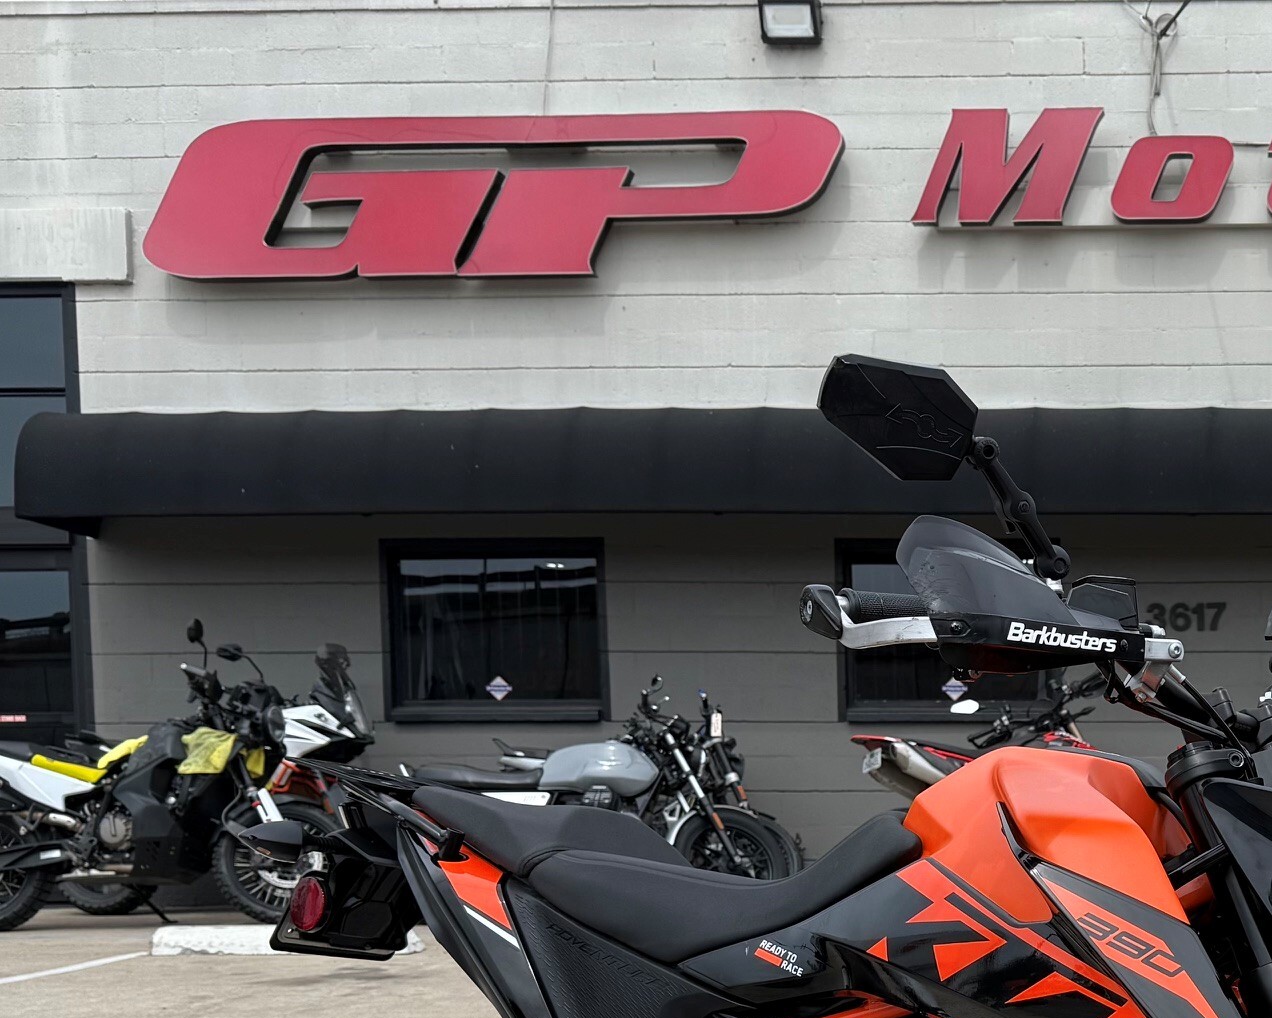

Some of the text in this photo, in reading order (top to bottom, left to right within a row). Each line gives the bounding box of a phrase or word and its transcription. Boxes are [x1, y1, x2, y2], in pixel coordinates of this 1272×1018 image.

[141, 109, 846, 279] GP
[1145, 602, 1227, 632] 3617
[1007, 621, 1117, 653] Barkbusters
[759, 939, 798, 963] READY TO
[1077, 912, 1184, 978] 390
[780, 960, 804, 977] RACE
